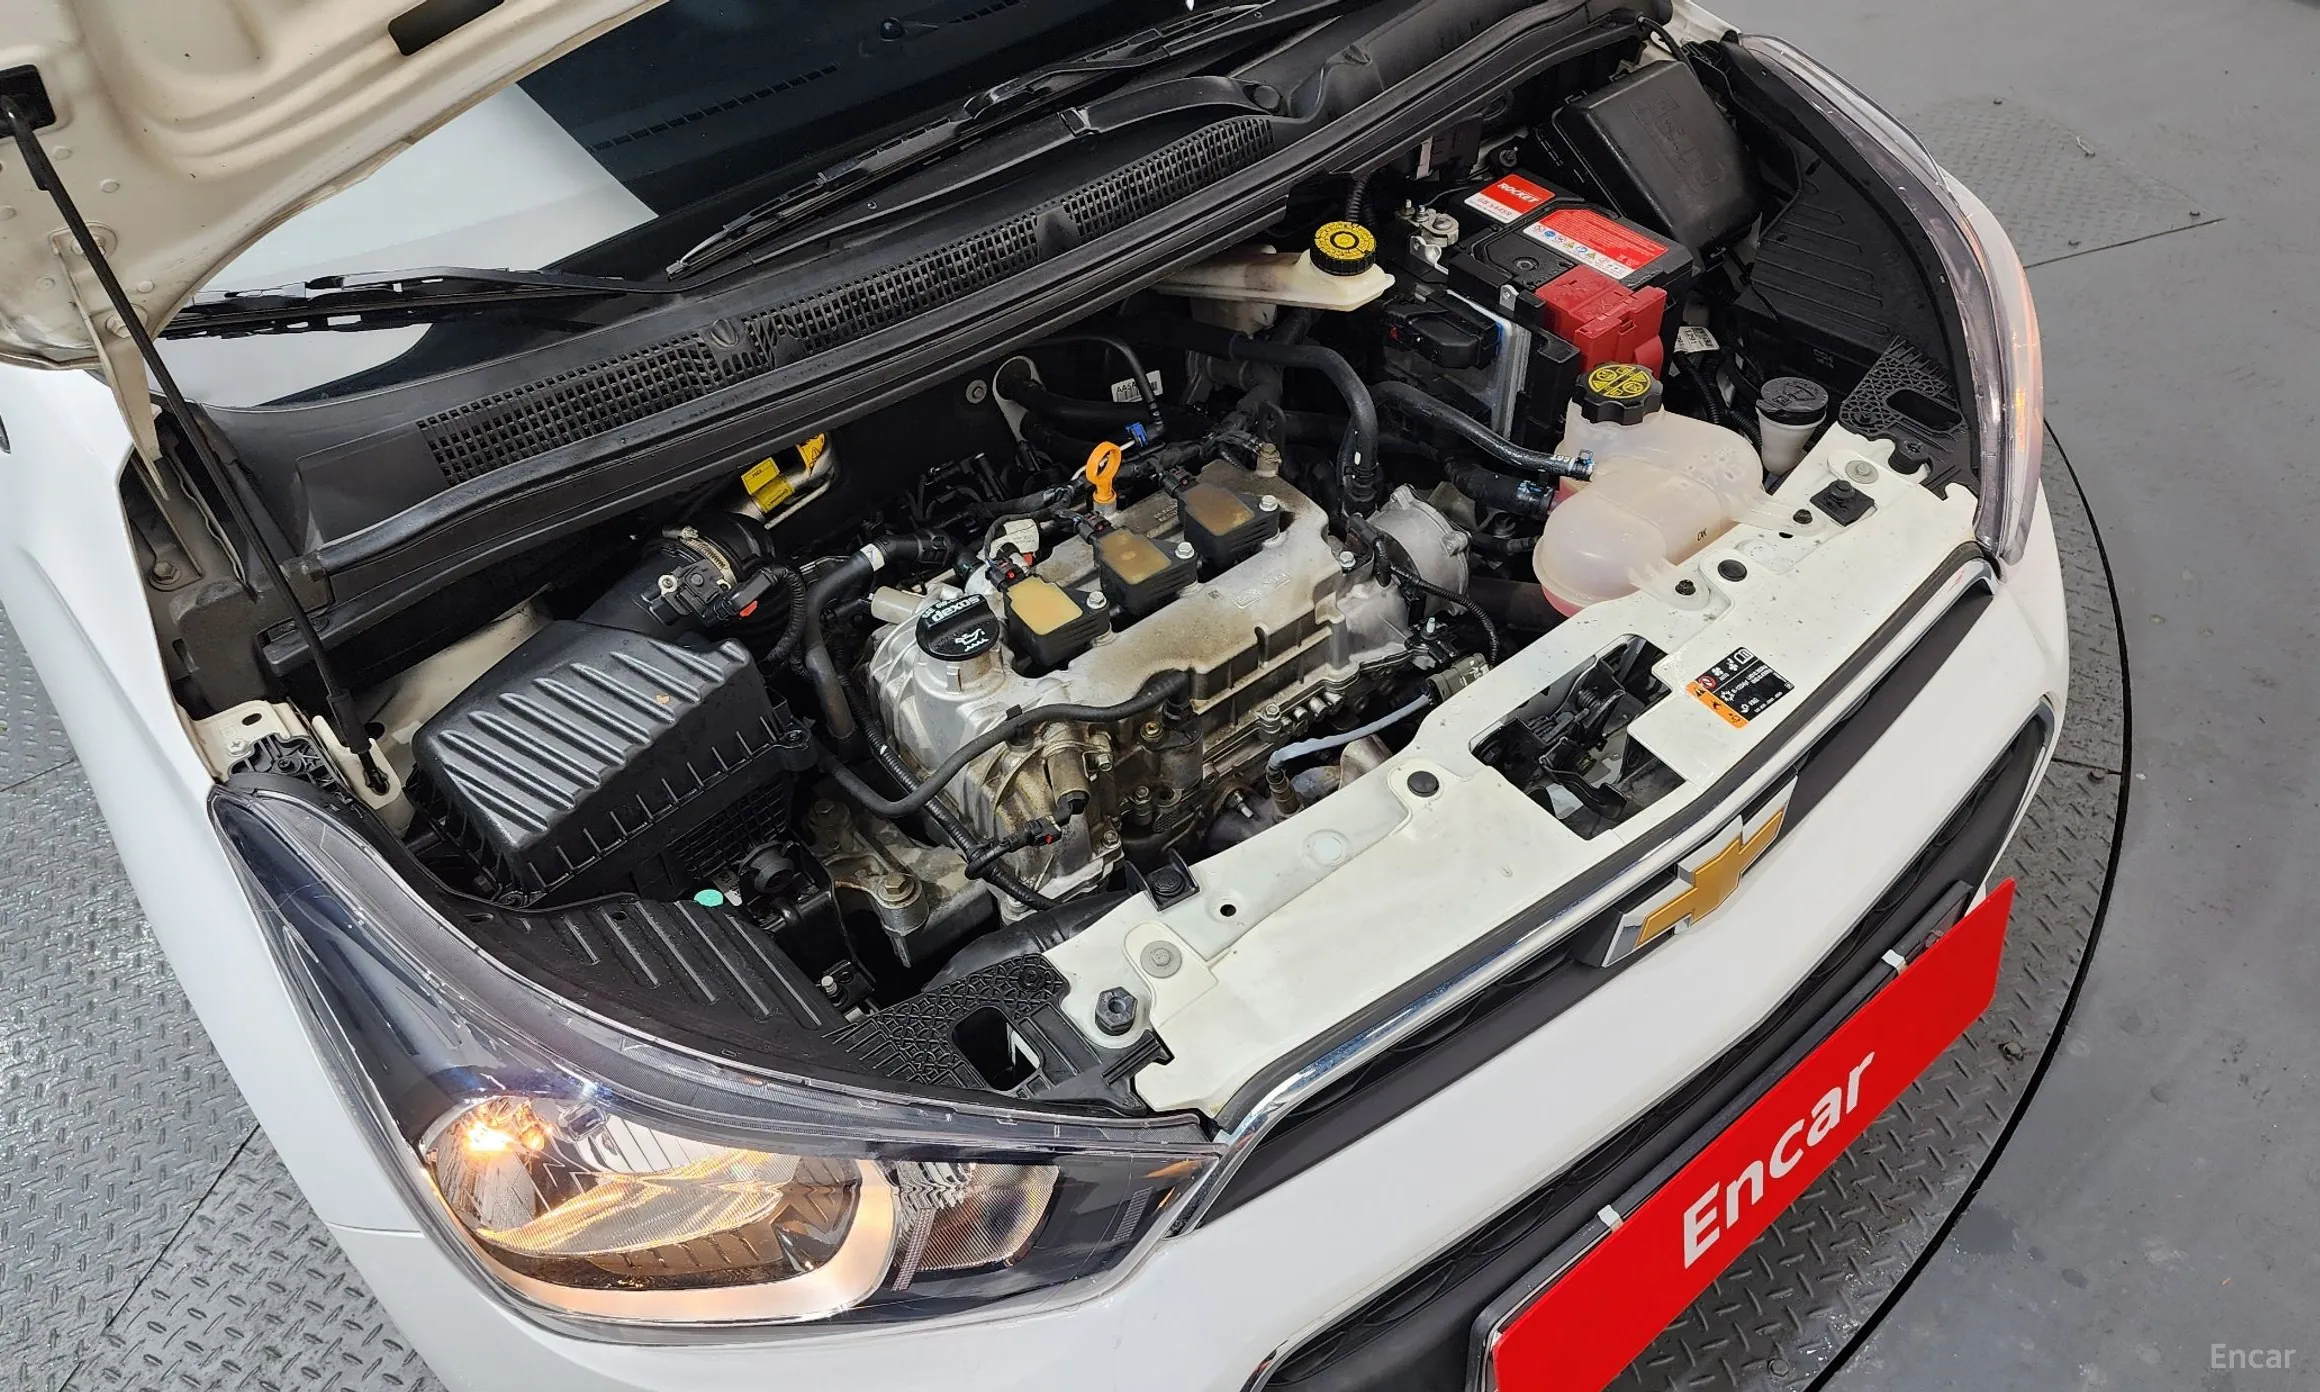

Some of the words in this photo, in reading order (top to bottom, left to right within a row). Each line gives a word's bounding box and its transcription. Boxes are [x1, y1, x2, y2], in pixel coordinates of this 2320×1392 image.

[1497, 183, 1540, 203] ROCKET
[931, 595, 981, 622] dexos
[1682, 1051, 1875, 1269] Encar
